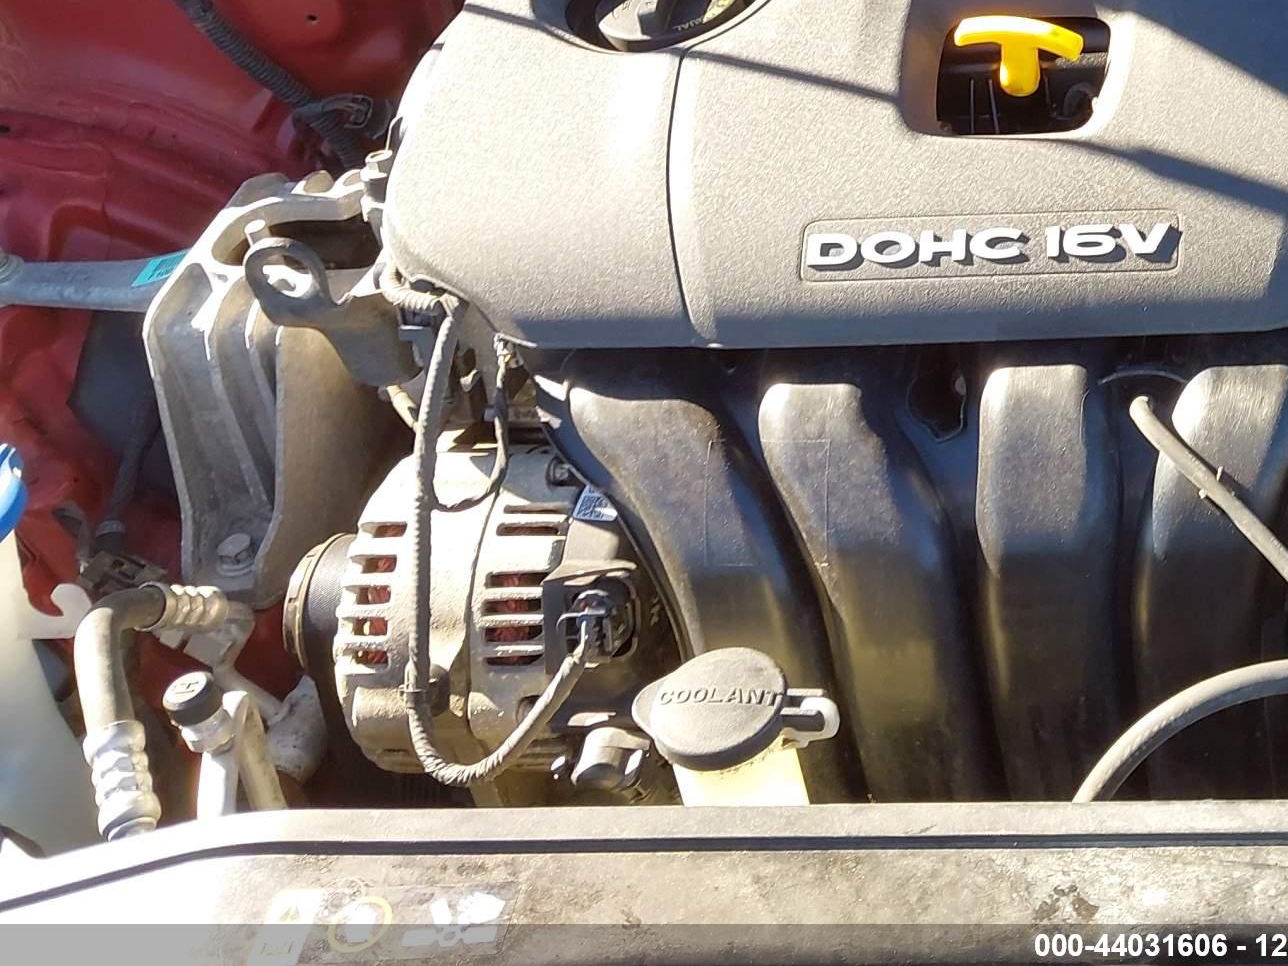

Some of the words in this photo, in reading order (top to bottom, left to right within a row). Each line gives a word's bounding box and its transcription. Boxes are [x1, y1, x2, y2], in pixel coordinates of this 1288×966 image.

[806, 226, 1028, 269] DOHC
[1045, 222, 1178, 263] 16V
[658, 687, 784, 707] COOLANT
